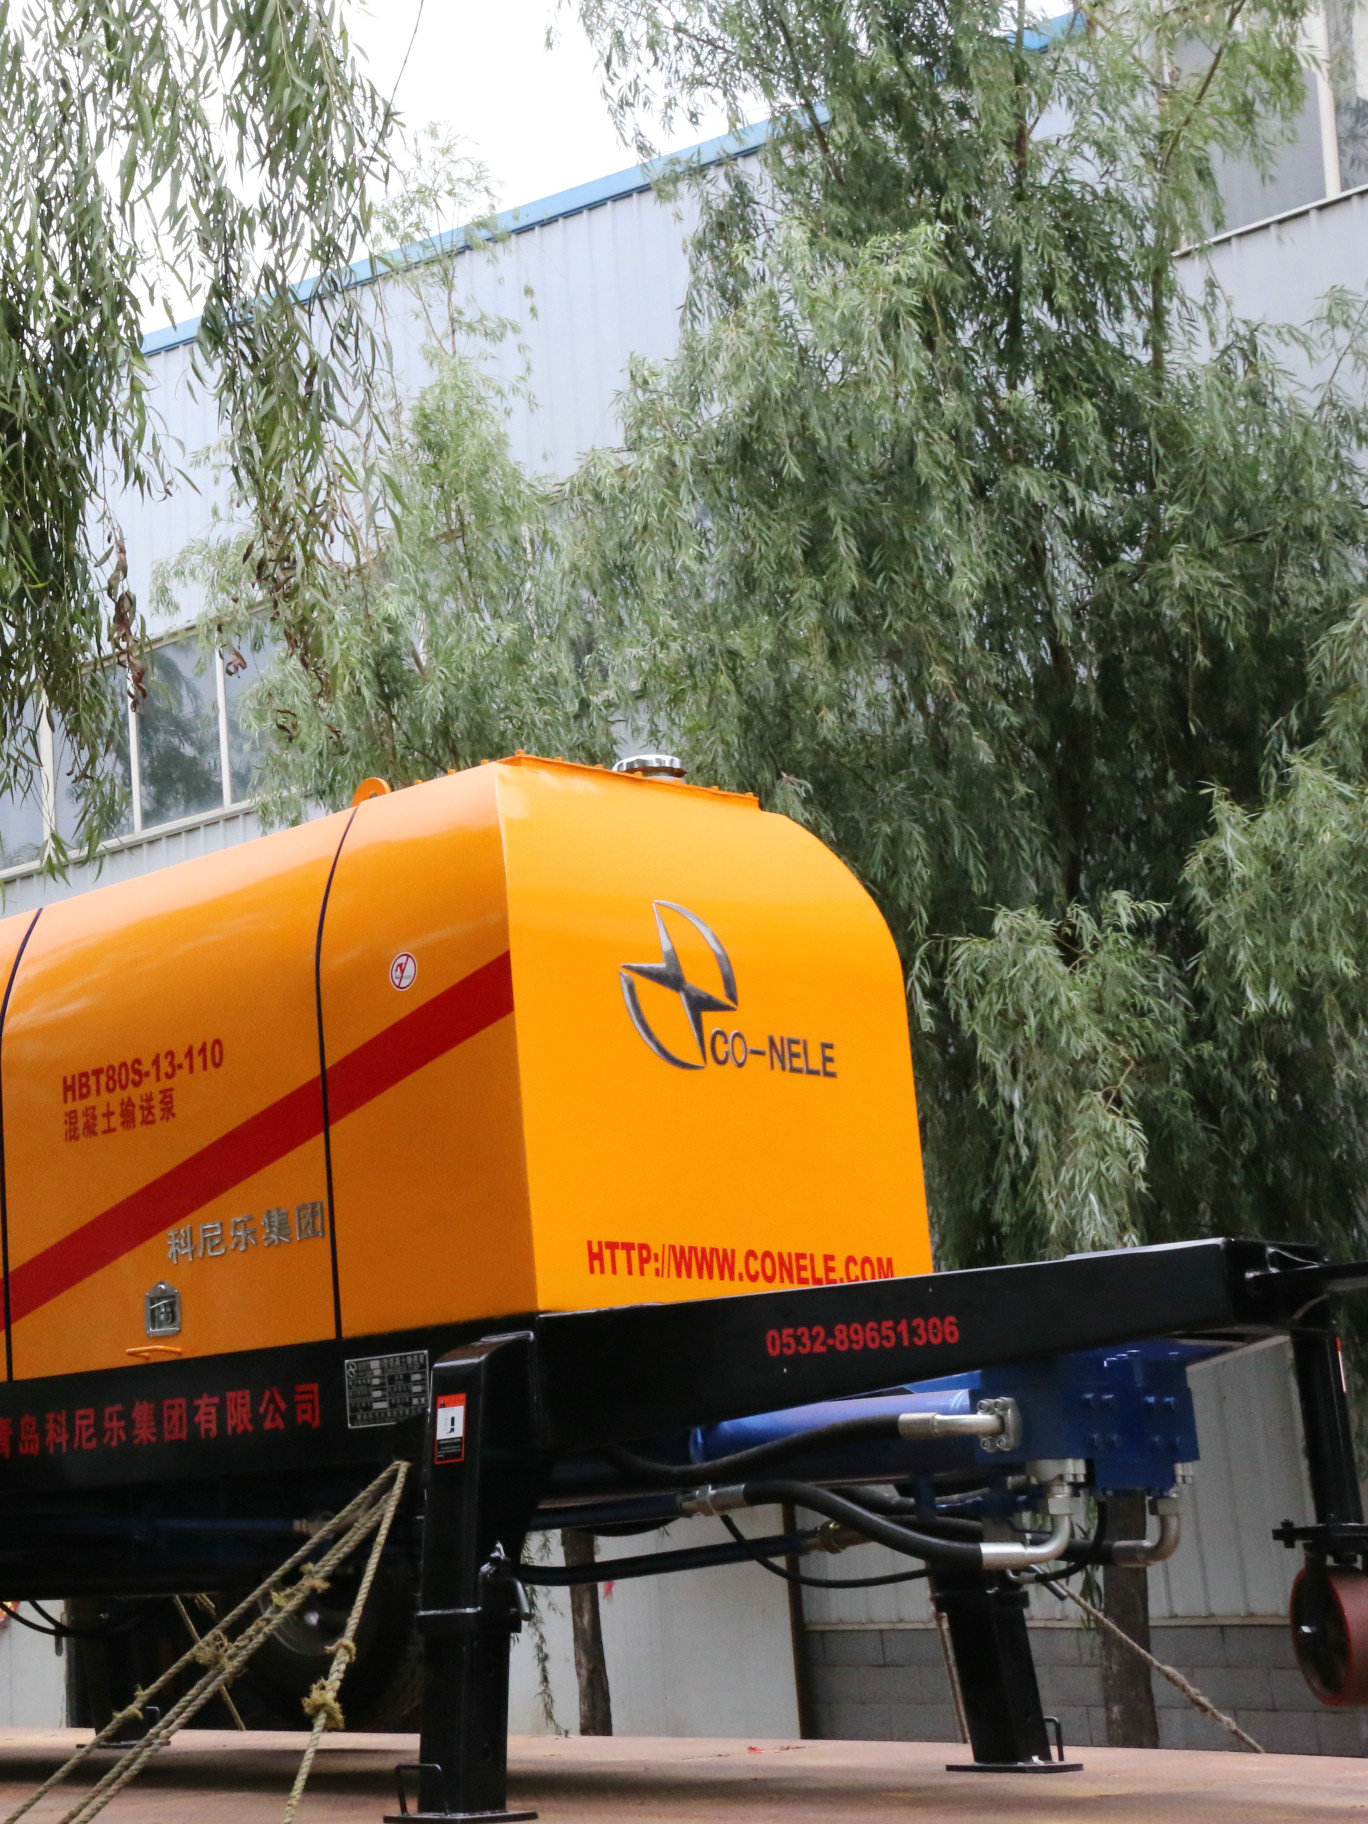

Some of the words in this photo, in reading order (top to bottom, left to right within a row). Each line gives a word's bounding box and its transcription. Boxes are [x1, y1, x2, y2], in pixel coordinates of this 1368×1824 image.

[62, 1038, 224, 1104] HBT80S-13-110
[710, 1028, 837, 1079] CO-NELE
[64, 1087, 176, 1142] 混凝土输送泵
[167, 1200, 326, 1265] 科尼乐集团
[586, 1239, 895, 1286] HTTP://WWW.CONELE.COM
[765, 1316, 960, 1358] 0532-89651306
